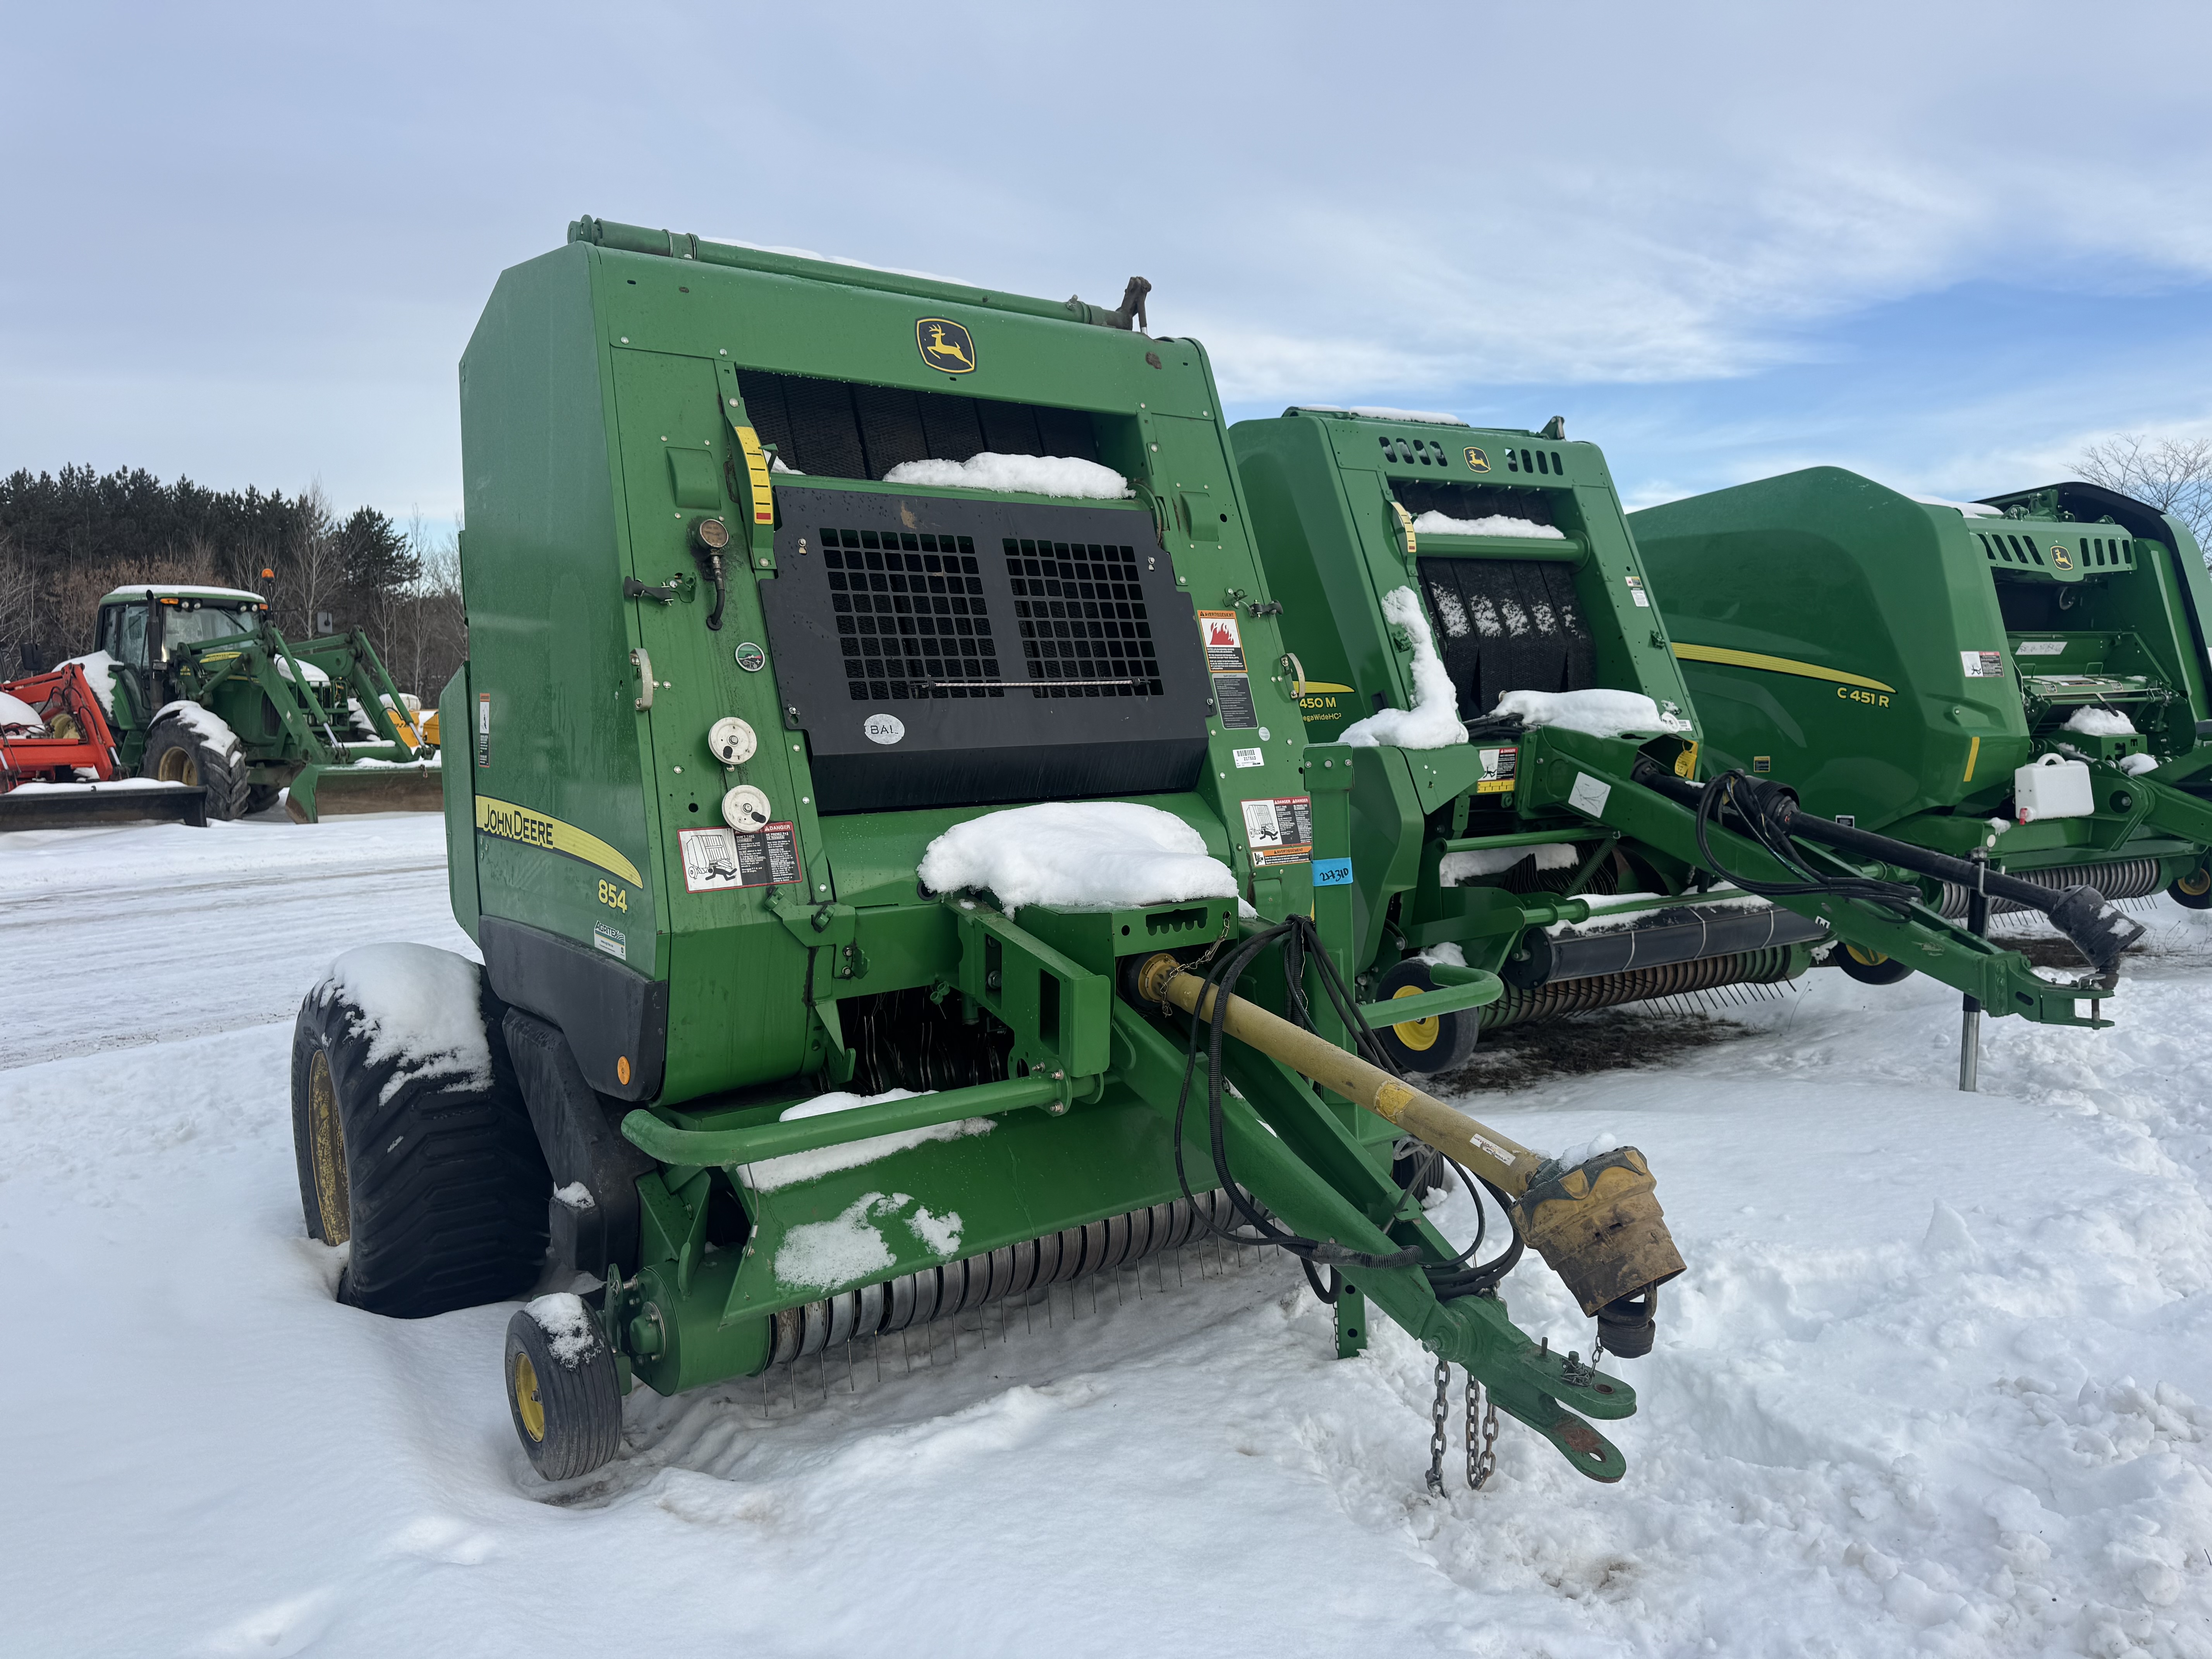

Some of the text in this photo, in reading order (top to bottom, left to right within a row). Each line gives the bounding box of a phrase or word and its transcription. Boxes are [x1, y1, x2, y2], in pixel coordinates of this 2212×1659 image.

[1299, 697, 1336, 708] 450 M
[1837, 687, 1889, 708] C 451 R
[1303, 713, 1342, 722] egaWideHC²
[484, 804, 553, 846] JOHN DEERE
[598, 879, 627, 914] 854
[595, 921, 618, 939] AGRITEX
